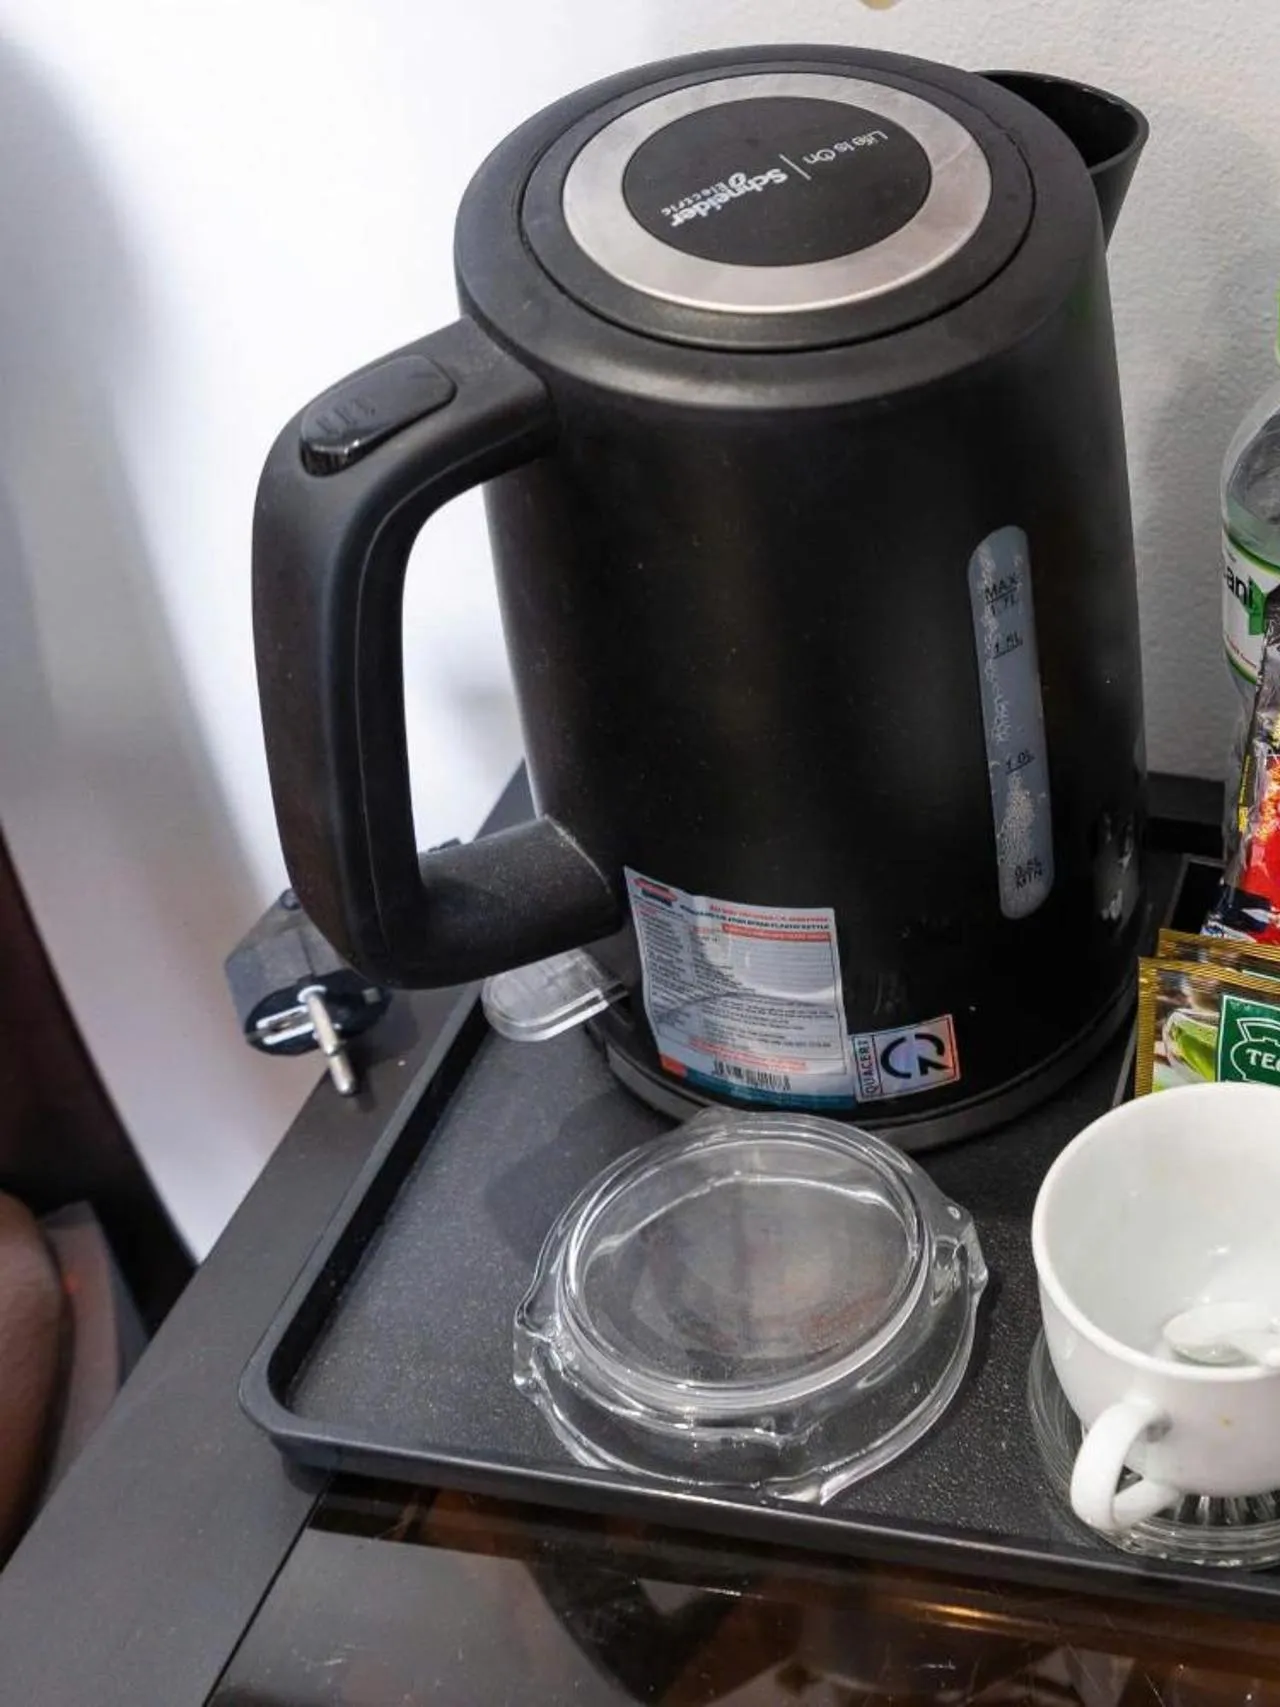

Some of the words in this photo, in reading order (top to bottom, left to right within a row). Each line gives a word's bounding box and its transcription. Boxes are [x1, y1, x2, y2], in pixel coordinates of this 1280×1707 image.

[834, 141, 855, 152] Is
[852, 130, 889, 147] Life
[803, 148, 836, 165] On
[671, 167, 788, 227] Schneider
[856, 1038, 878, 1096] QUACERT
